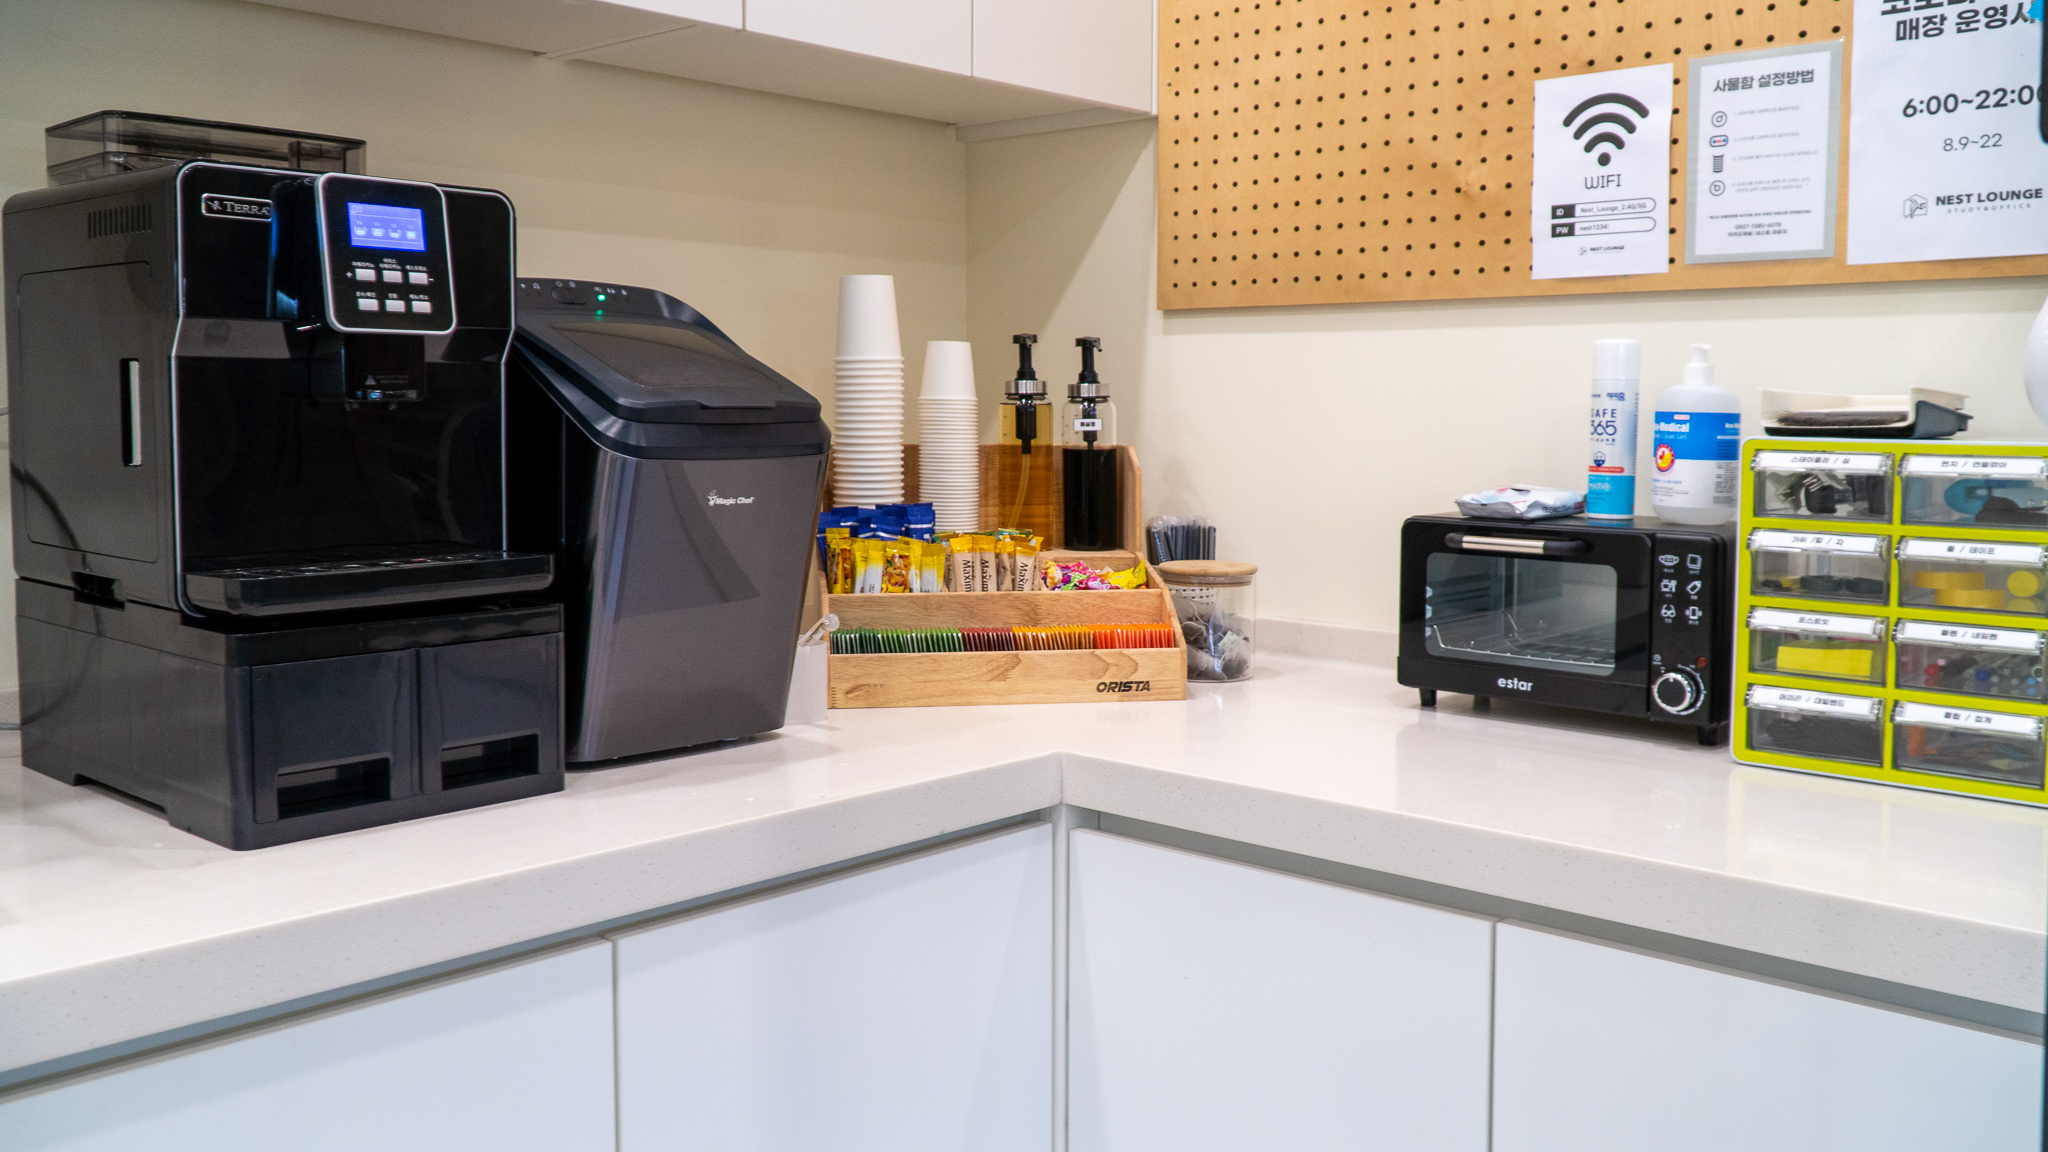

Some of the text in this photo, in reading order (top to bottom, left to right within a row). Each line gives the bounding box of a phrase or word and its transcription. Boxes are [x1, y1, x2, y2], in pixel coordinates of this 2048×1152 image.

[1895, 13, 1948, 42] 매장
[1713, 68, 1815, 92] 사물함 설정방법
[1943, 133, 2003, 152] 8.9~22
[1584, 173, 1622, 190] WIFI
[1935, 188, 2043, 206] NEST LOUNGE
[223, 201, 270, 216] TERRA
[1555, 208, 1565, 216] ID
[1555, 226, 1570, 235] PW
[715, 496, 755, 505] Magic Chef
[1968, 546, 1996, 555] 테이프
[962, 559, 972, 592] Maxim
[981, 559, 989, 592] Maxim
[1096, 681, 1151, 693] ORISTA
[1497, 677, 1534, 691] estar
